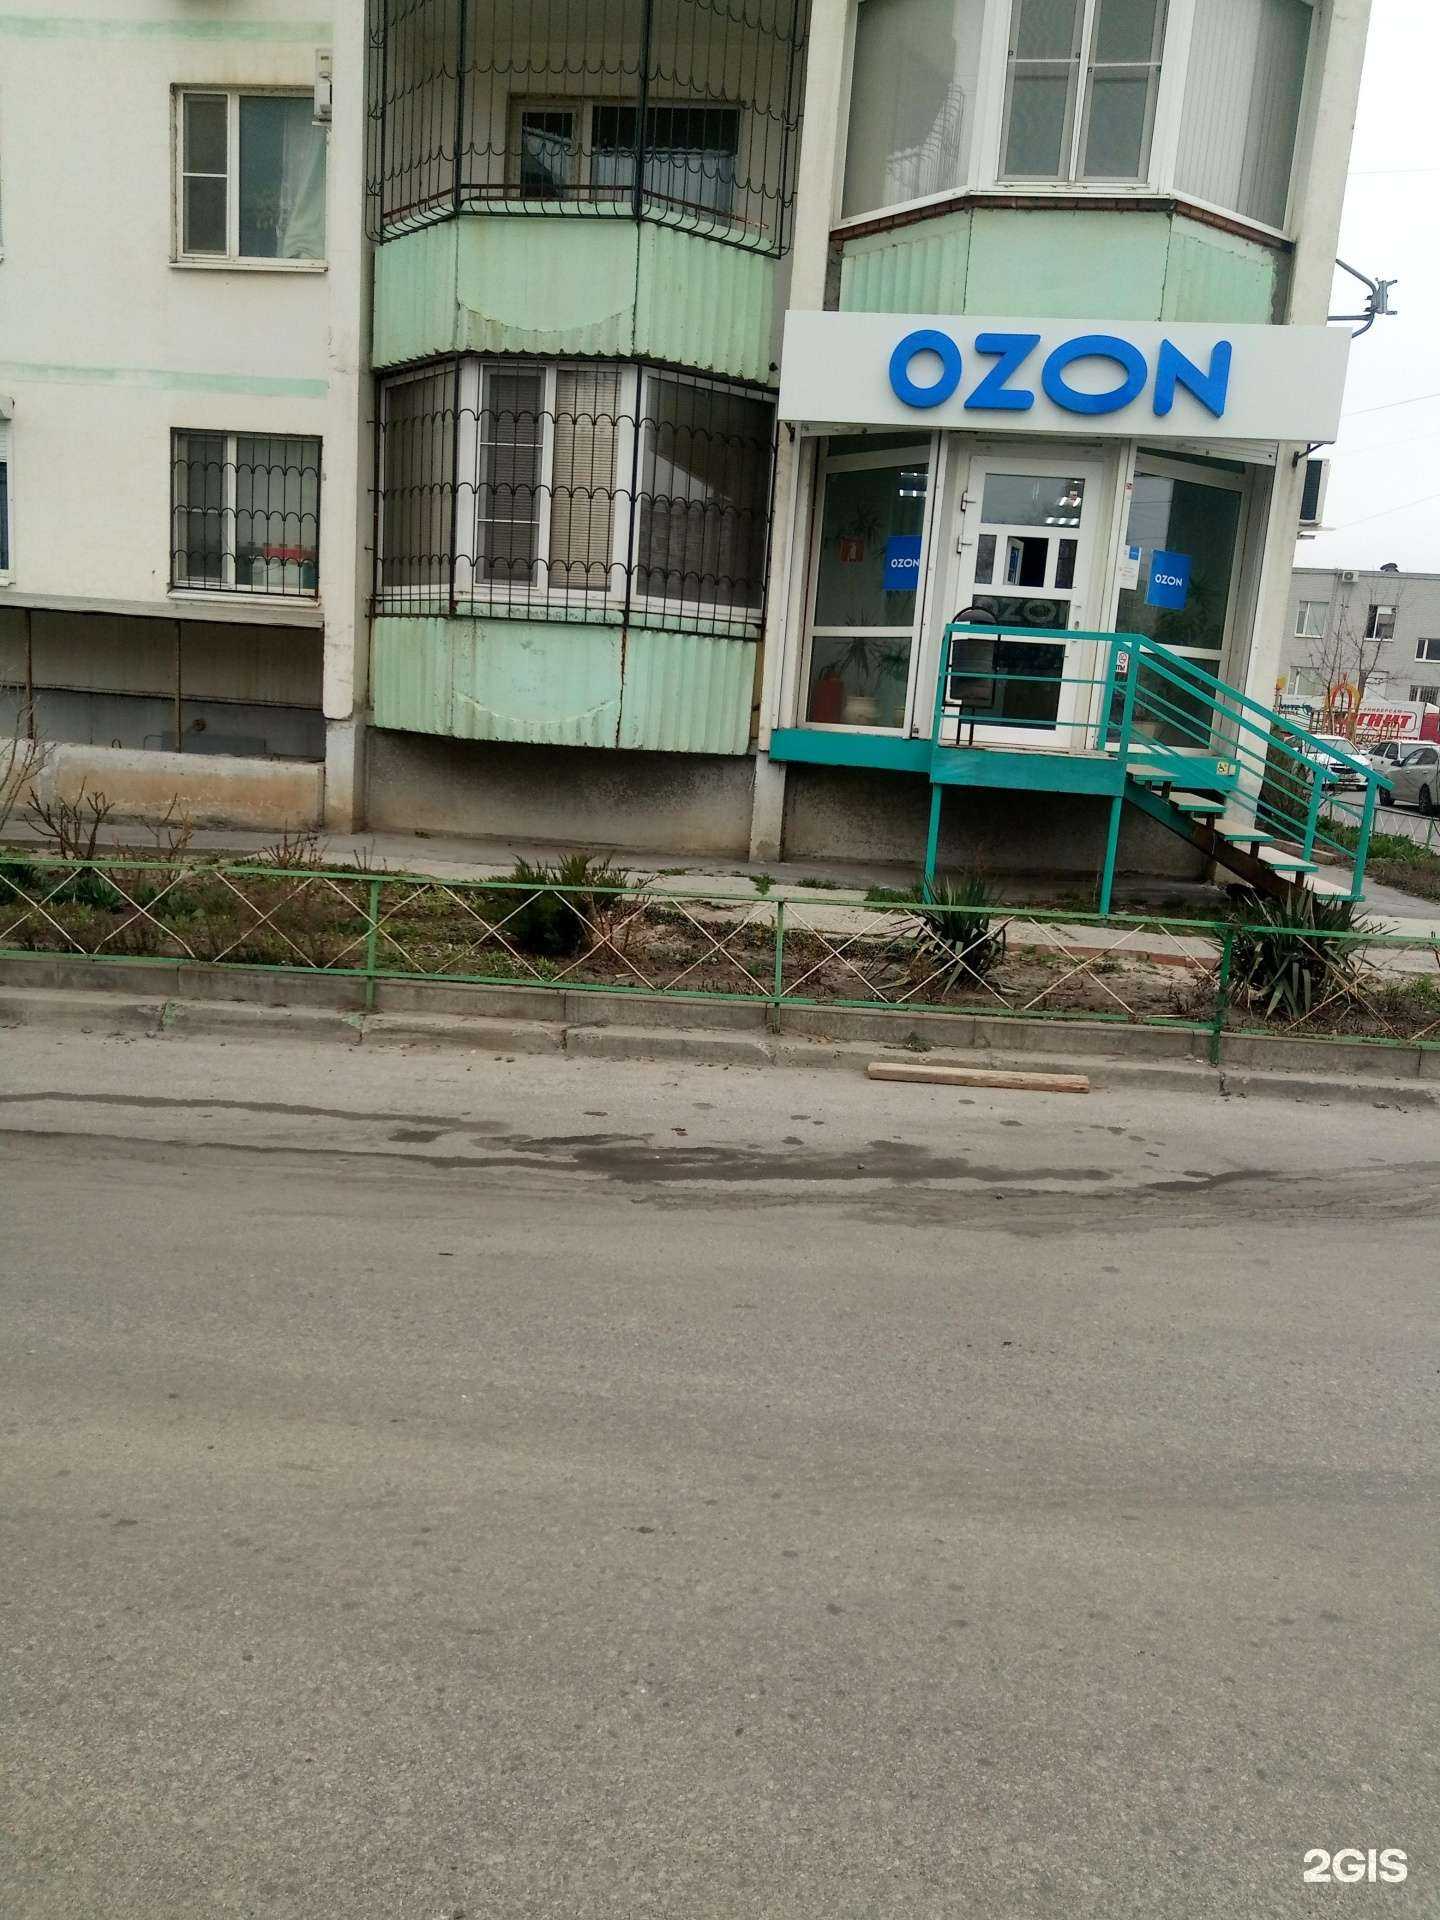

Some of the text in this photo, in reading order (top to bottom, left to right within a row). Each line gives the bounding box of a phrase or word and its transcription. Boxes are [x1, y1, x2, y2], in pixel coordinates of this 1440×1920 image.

[888, 329, 1233, 419] OZON
[890, 557, 920, 569] OZON
[1154, 573, 1184, 587] OZON
